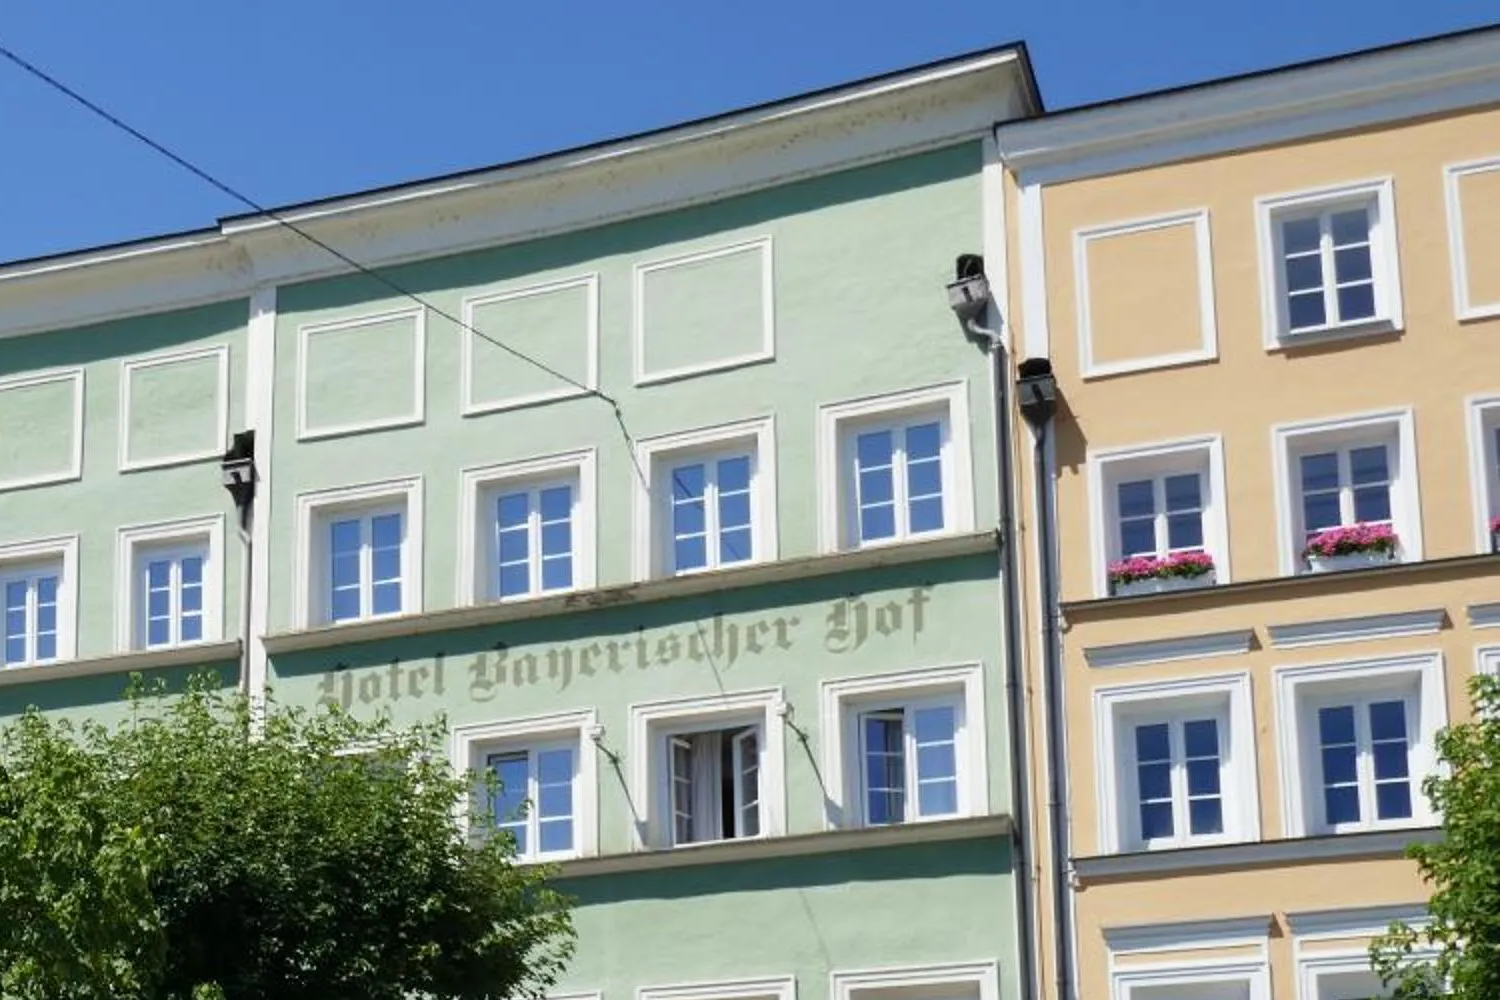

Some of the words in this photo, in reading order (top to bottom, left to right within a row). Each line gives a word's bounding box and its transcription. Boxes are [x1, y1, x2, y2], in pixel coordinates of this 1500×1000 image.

[317, 652, 448, 711] Hotel
[467, 612, 799, 702] Bayerischer
[824, 581, 934, 654] Hof
